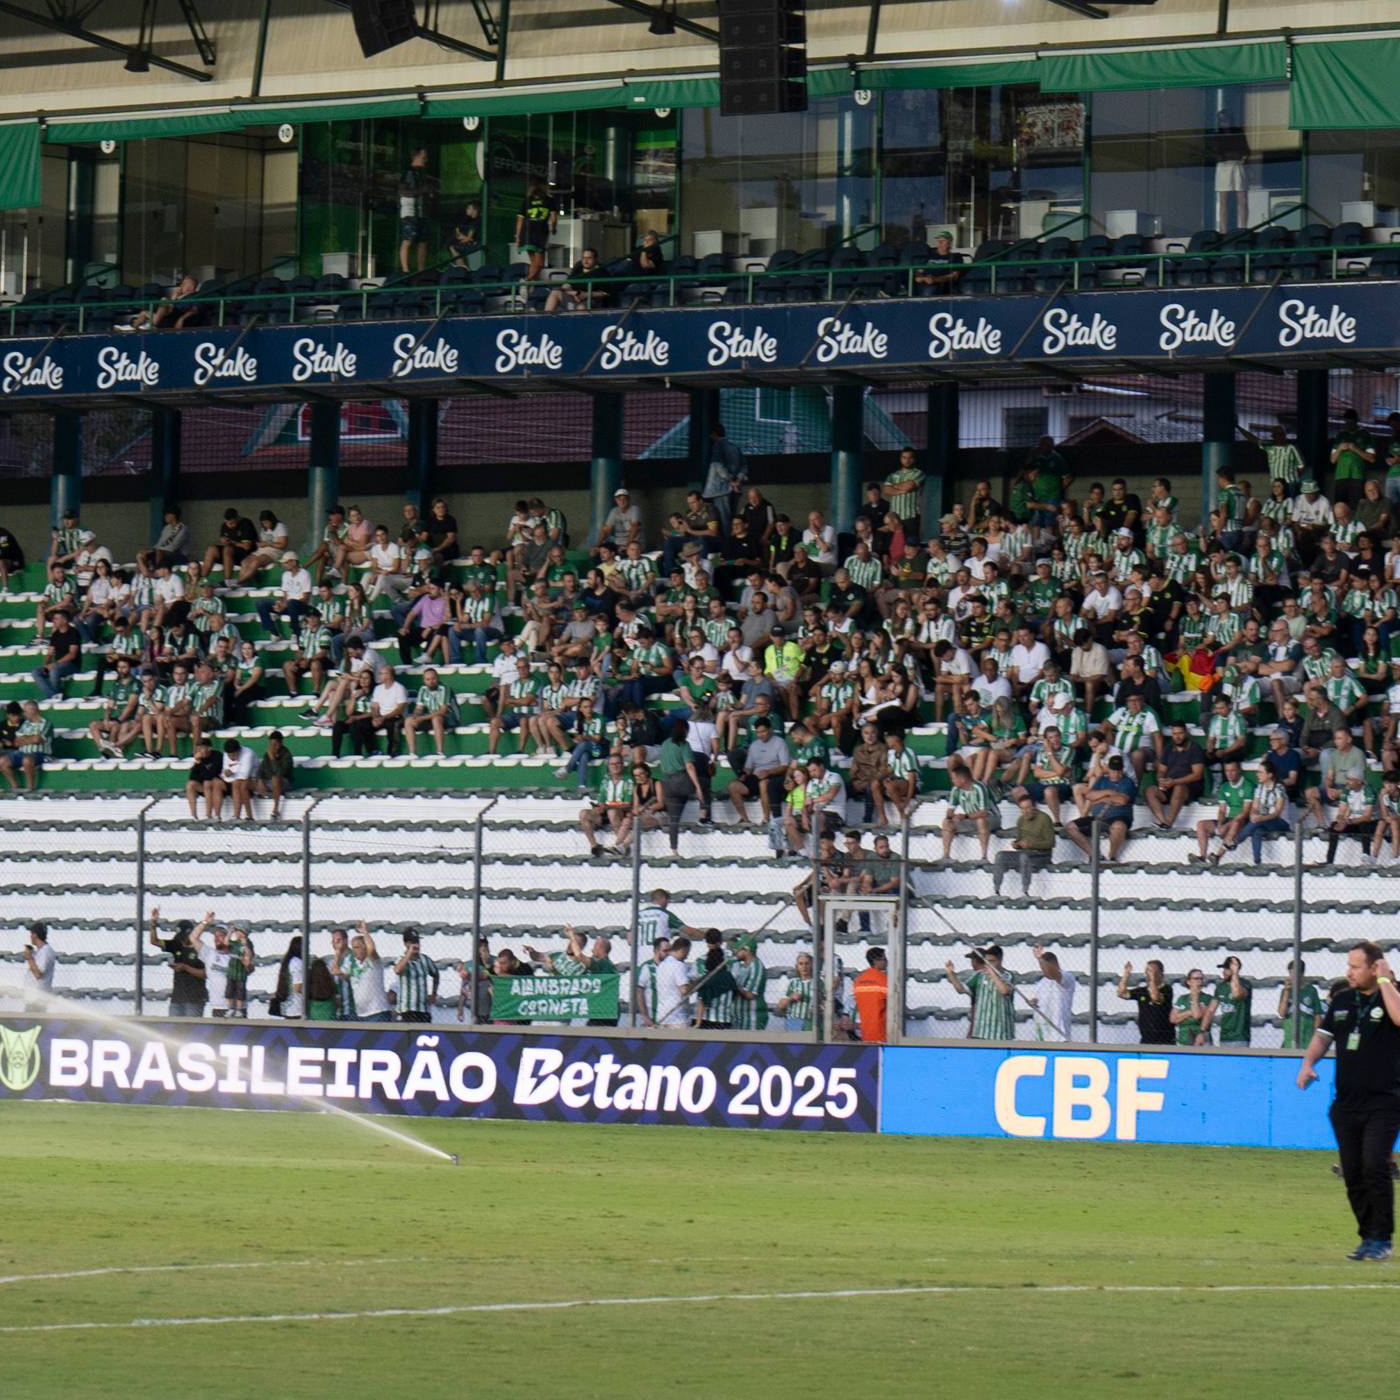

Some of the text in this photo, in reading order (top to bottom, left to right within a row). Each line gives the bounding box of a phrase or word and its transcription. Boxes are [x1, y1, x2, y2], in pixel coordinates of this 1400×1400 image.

[708, 321, 776, 366] Stake
[817, 317, 887, 363] Stake
[929, 312, 1001, 359] Stake
[1043, 308, 1116, 355] Stake
[1160, 304, 1235, 351] Stake
[1279, 300, 1356, 347] Stake
[98, 347, 159, 389] Stake
[293, 338, 356, 381] Stake
[393, 333, 458, 376] Stake
[496, 329, 562, 373] Stake
[601, 325, 668, 370] Stake
[517, 998, 589, 1016] CORNETA
[49, 1036, 859, 1119] BRASILEIRÃO Betano 2025
[994, 1055, 1169, 1140] CBF
